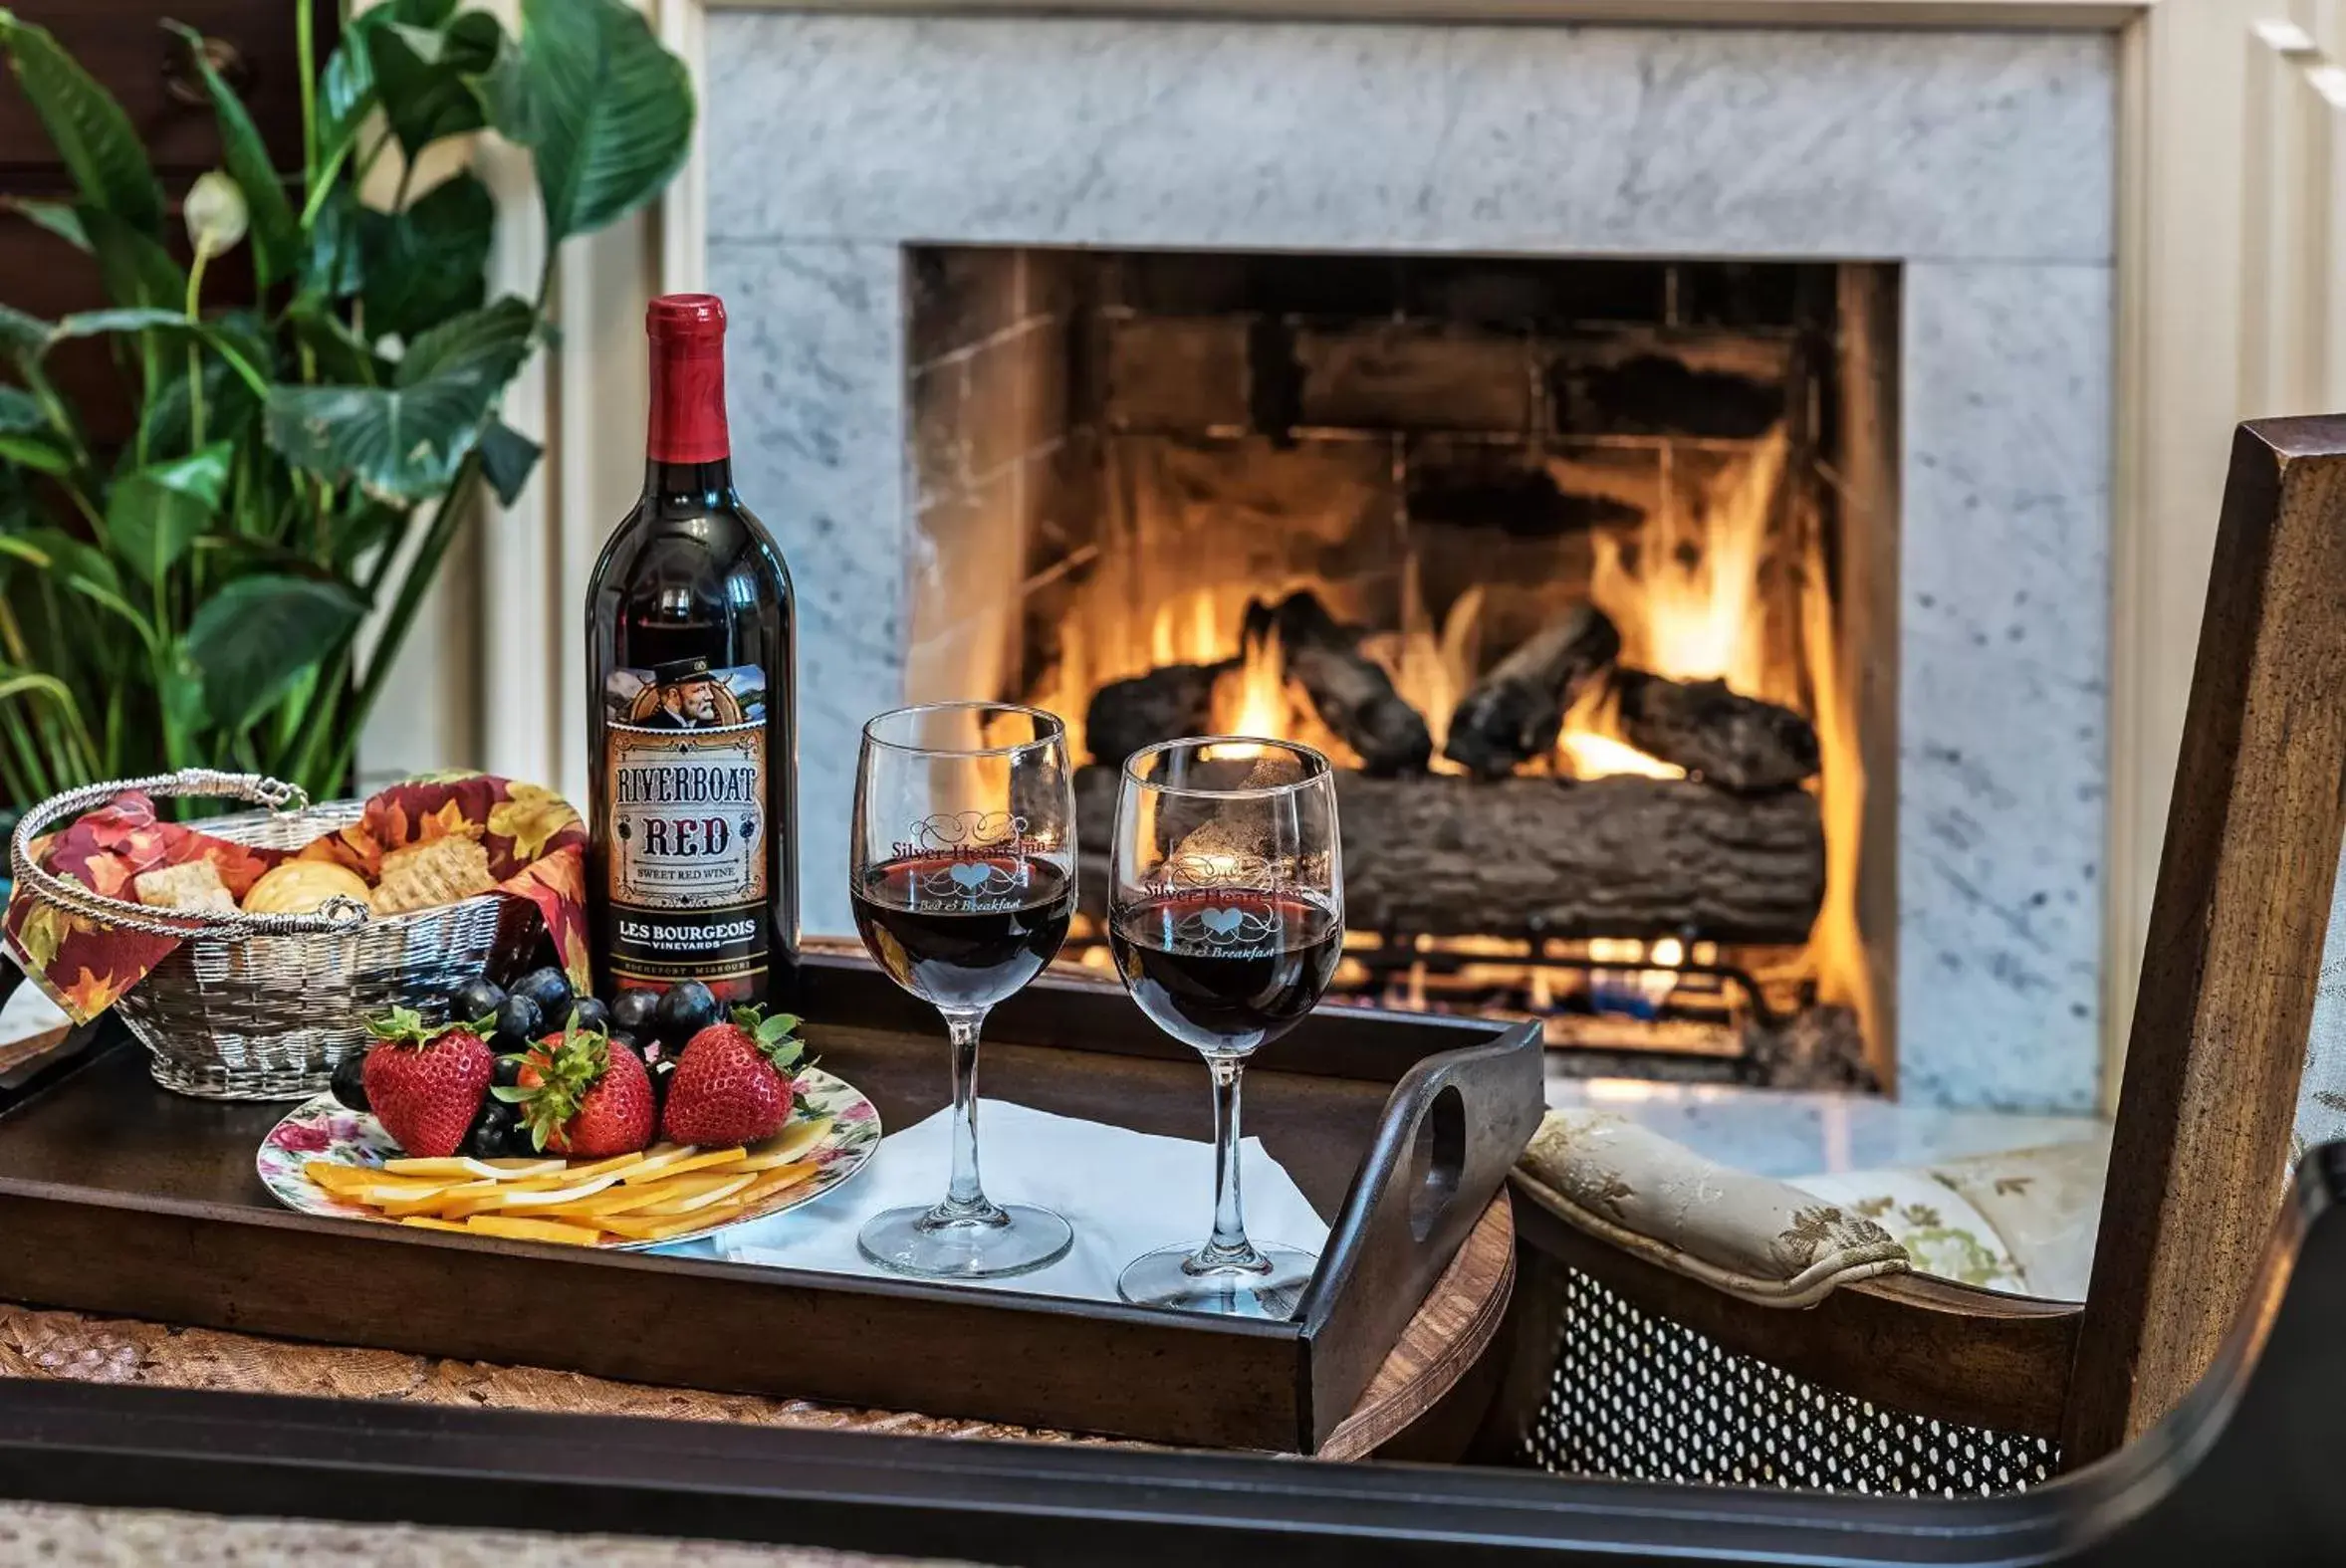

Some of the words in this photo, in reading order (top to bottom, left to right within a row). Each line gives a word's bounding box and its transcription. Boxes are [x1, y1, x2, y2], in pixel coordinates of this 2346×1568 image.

[617, 768, 757, 802] RIVERBOAT
[643, 817, 730, 856] RED
[891, 841, 943, 860] Silver
[637, 867, 676, 880] SWEET
[678, 869, 702, 880] RED
[703, 867, 736, 878] WINE
[1144, 883, 1197, 902] Silver
[619, 920, 650, 939] LES
[653, 919, 756, 941] BOURGEOIS
[652, 941, 721, 951] VINEYARDS
[1212, 946, 1275, 962] Breakfast
[695, 961, 751, 975] MISSOURI
